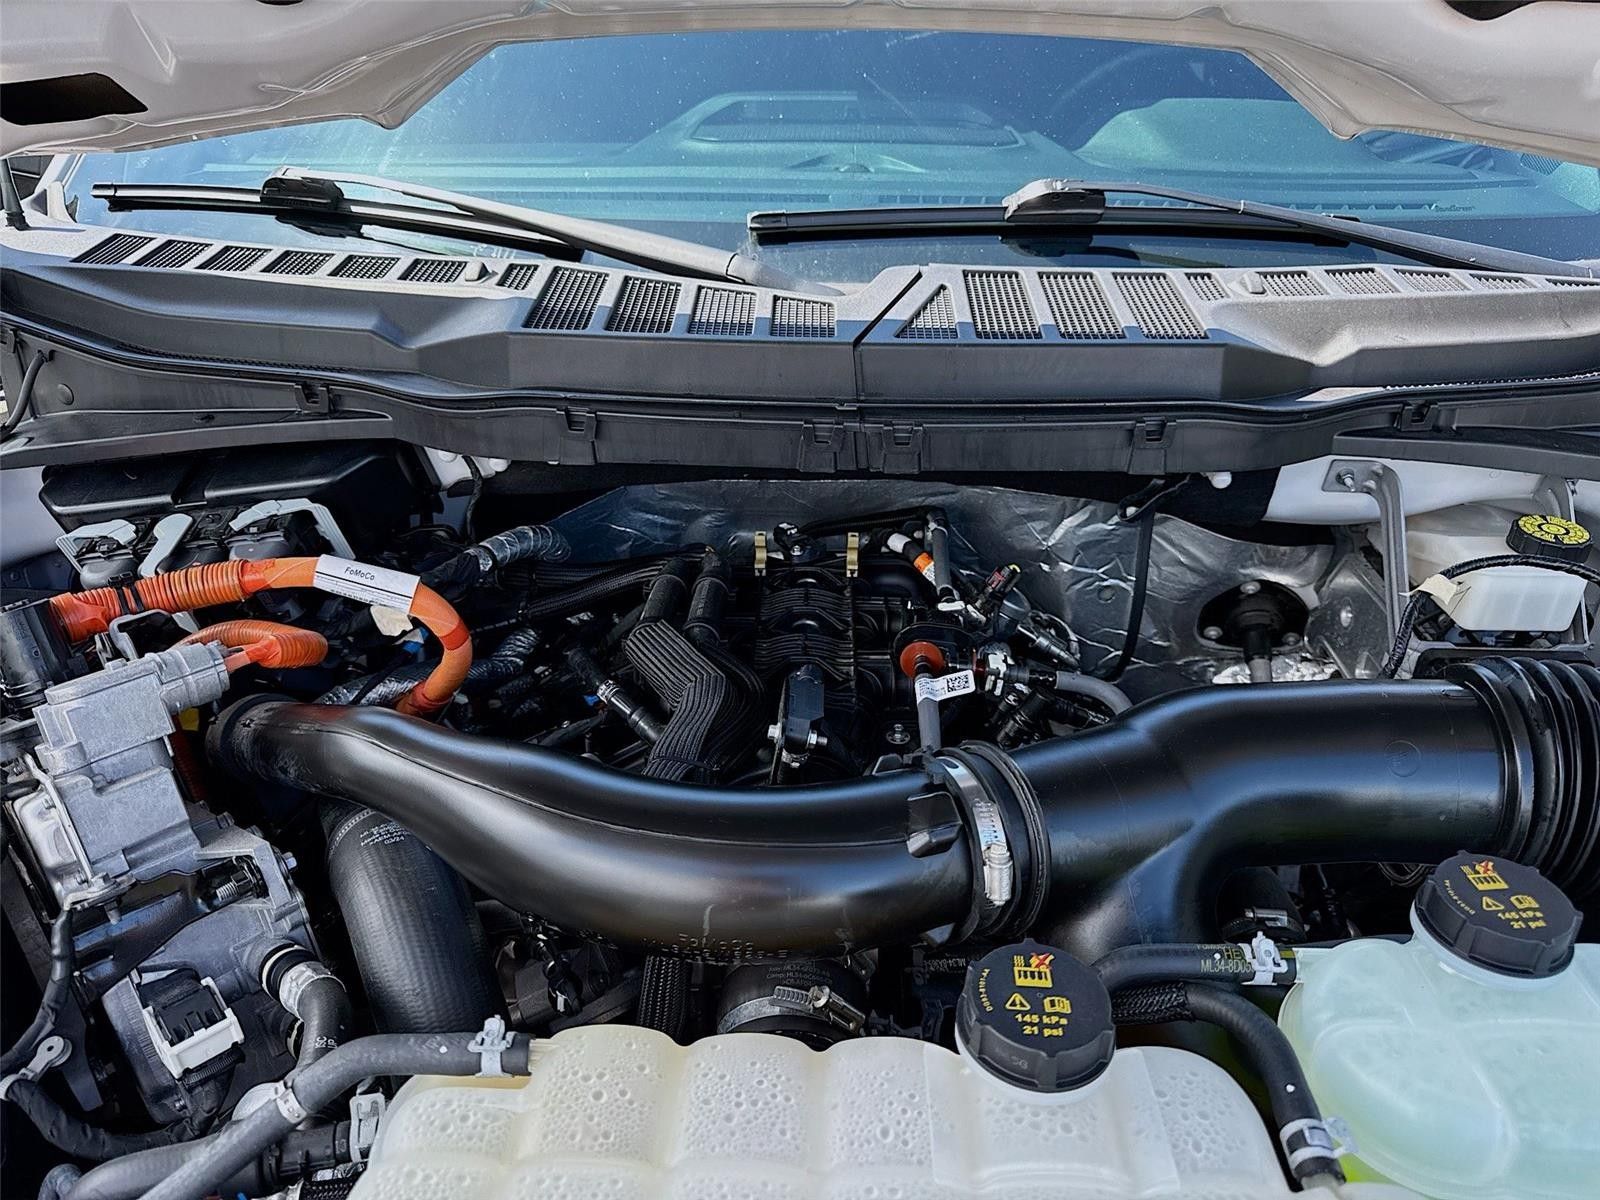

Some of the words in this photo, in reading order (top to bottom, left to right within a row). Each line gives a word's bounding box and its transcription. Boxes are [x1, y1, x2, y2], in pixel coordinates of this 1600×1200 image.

[344, 566, 376, 581] FoMoCo
[1497, 911, 1520, 920] 145
[1520, 911, 1544, 919] kPa
[1510, 920, 1526, 929] 21
[1528, 920, 1547, 930] psi
[1201, 958, 1255, 973] ML34-8D05
[1015, 1013, 1040, 1024] 145
[1042, 1015, 1068, 1025] kPa
[1023, 1025, 1039, 1035] 21
[1043, 1027, 1064, 1037] psi
